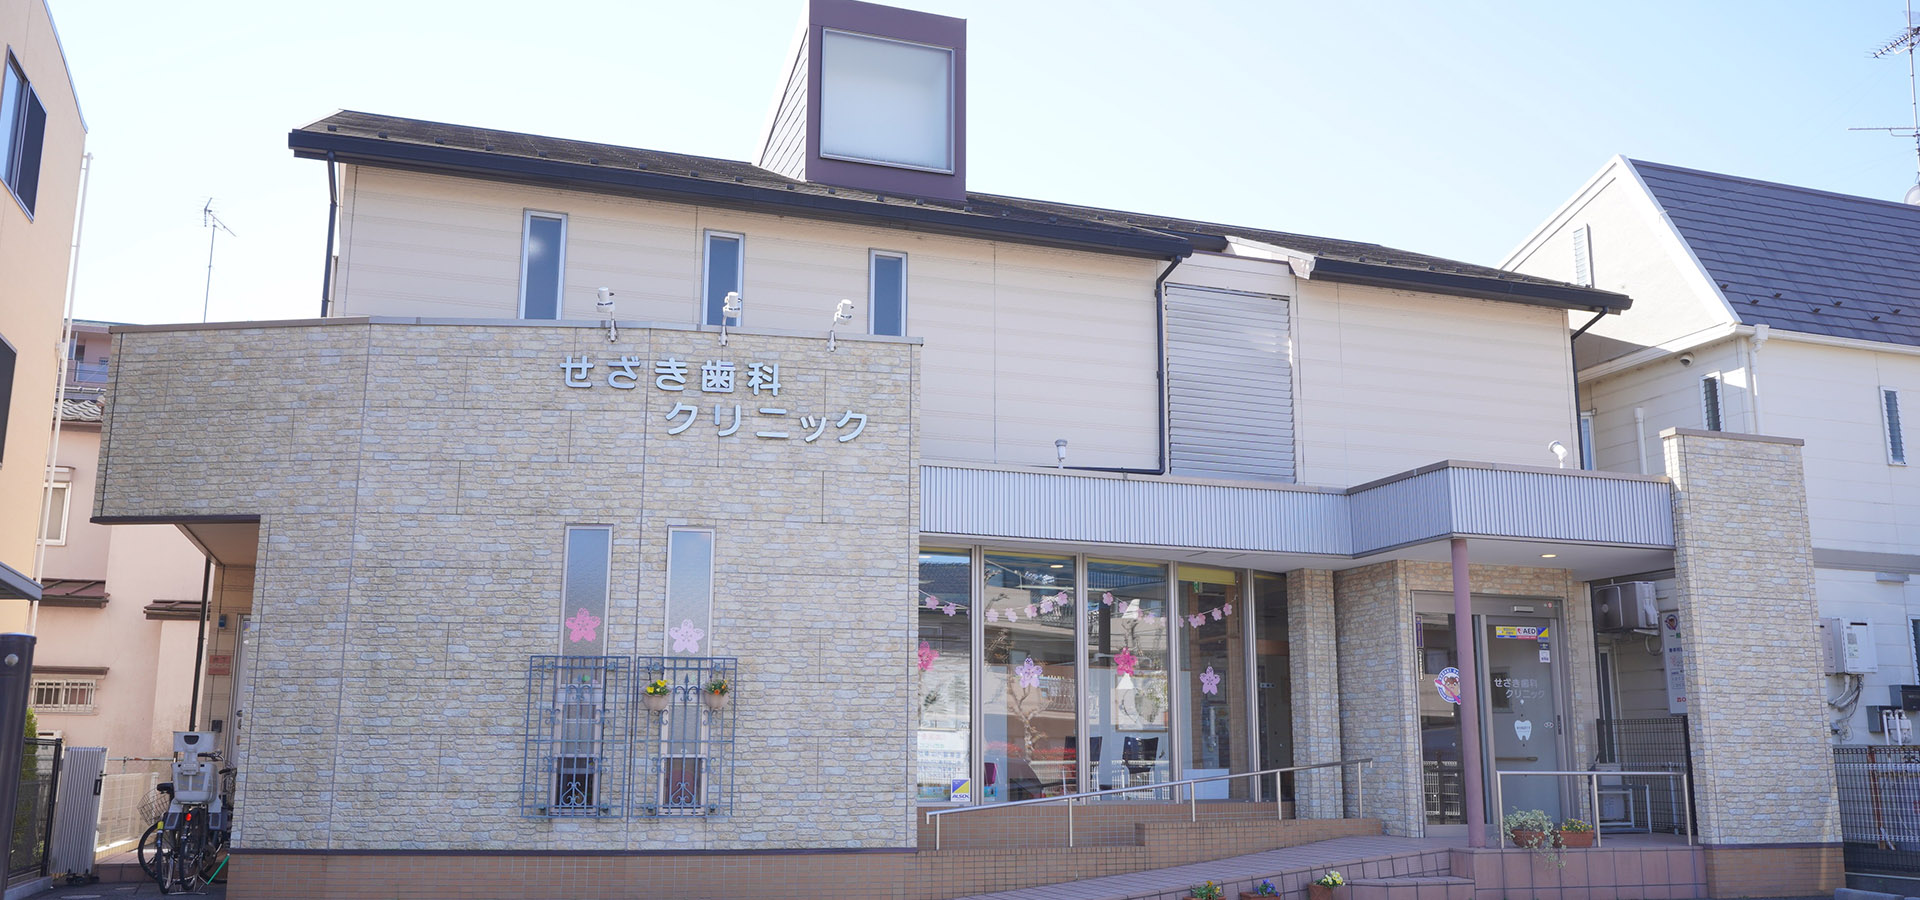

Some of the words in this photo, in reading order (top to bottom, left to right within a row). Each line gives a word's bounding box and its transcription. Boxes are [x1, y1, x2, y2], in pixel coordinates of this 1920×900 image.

[559, 355, 782, 397] せざき歯科
[665, 402, 868, 443] クリニック
